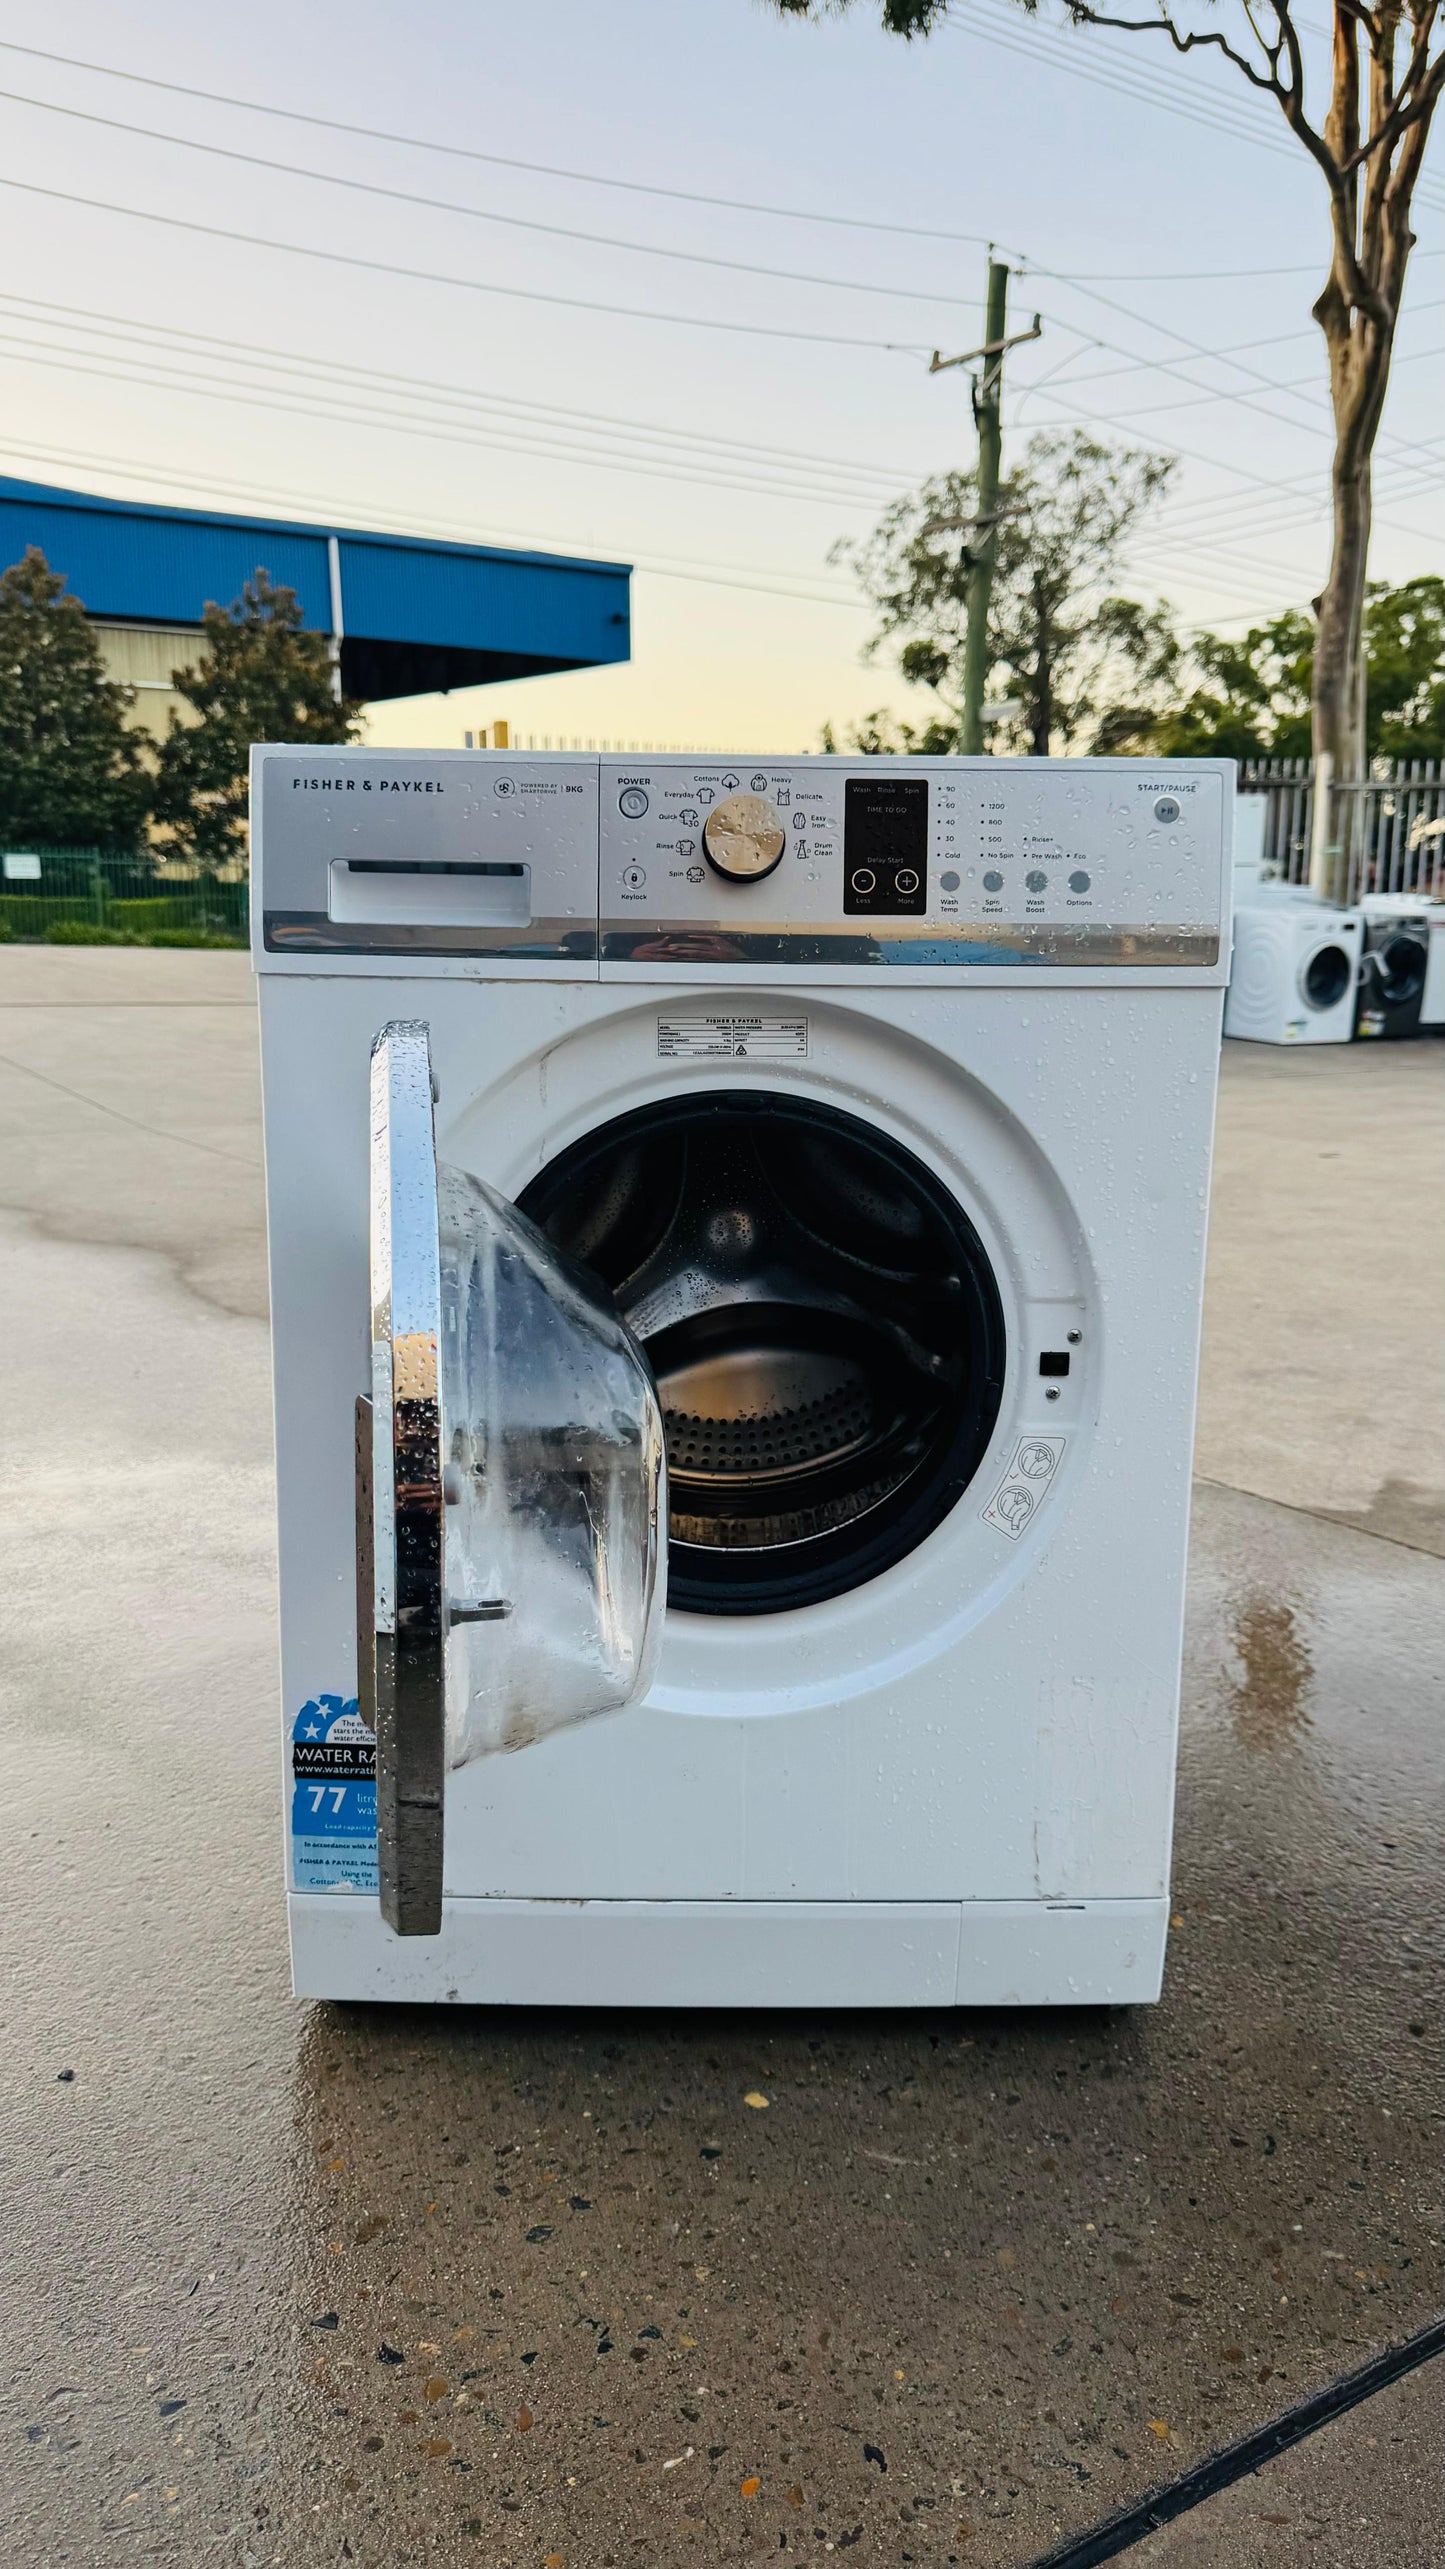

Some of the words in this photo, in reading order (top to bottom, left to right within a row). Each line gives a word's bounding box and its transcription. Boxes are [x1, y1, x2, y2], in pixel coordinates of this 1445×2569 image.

[293, 779, 356, 790] FISHER
[362, 781, 372, 791] &
[380, 781, 444, 792] PAYKEL
[1138, 784, 1196, 792] START/PAUSE
[296, 1748, 354, 1762] WATER
[308, 1786, 347, 1814] 77
[342, 1870, 360, 1878] Using
